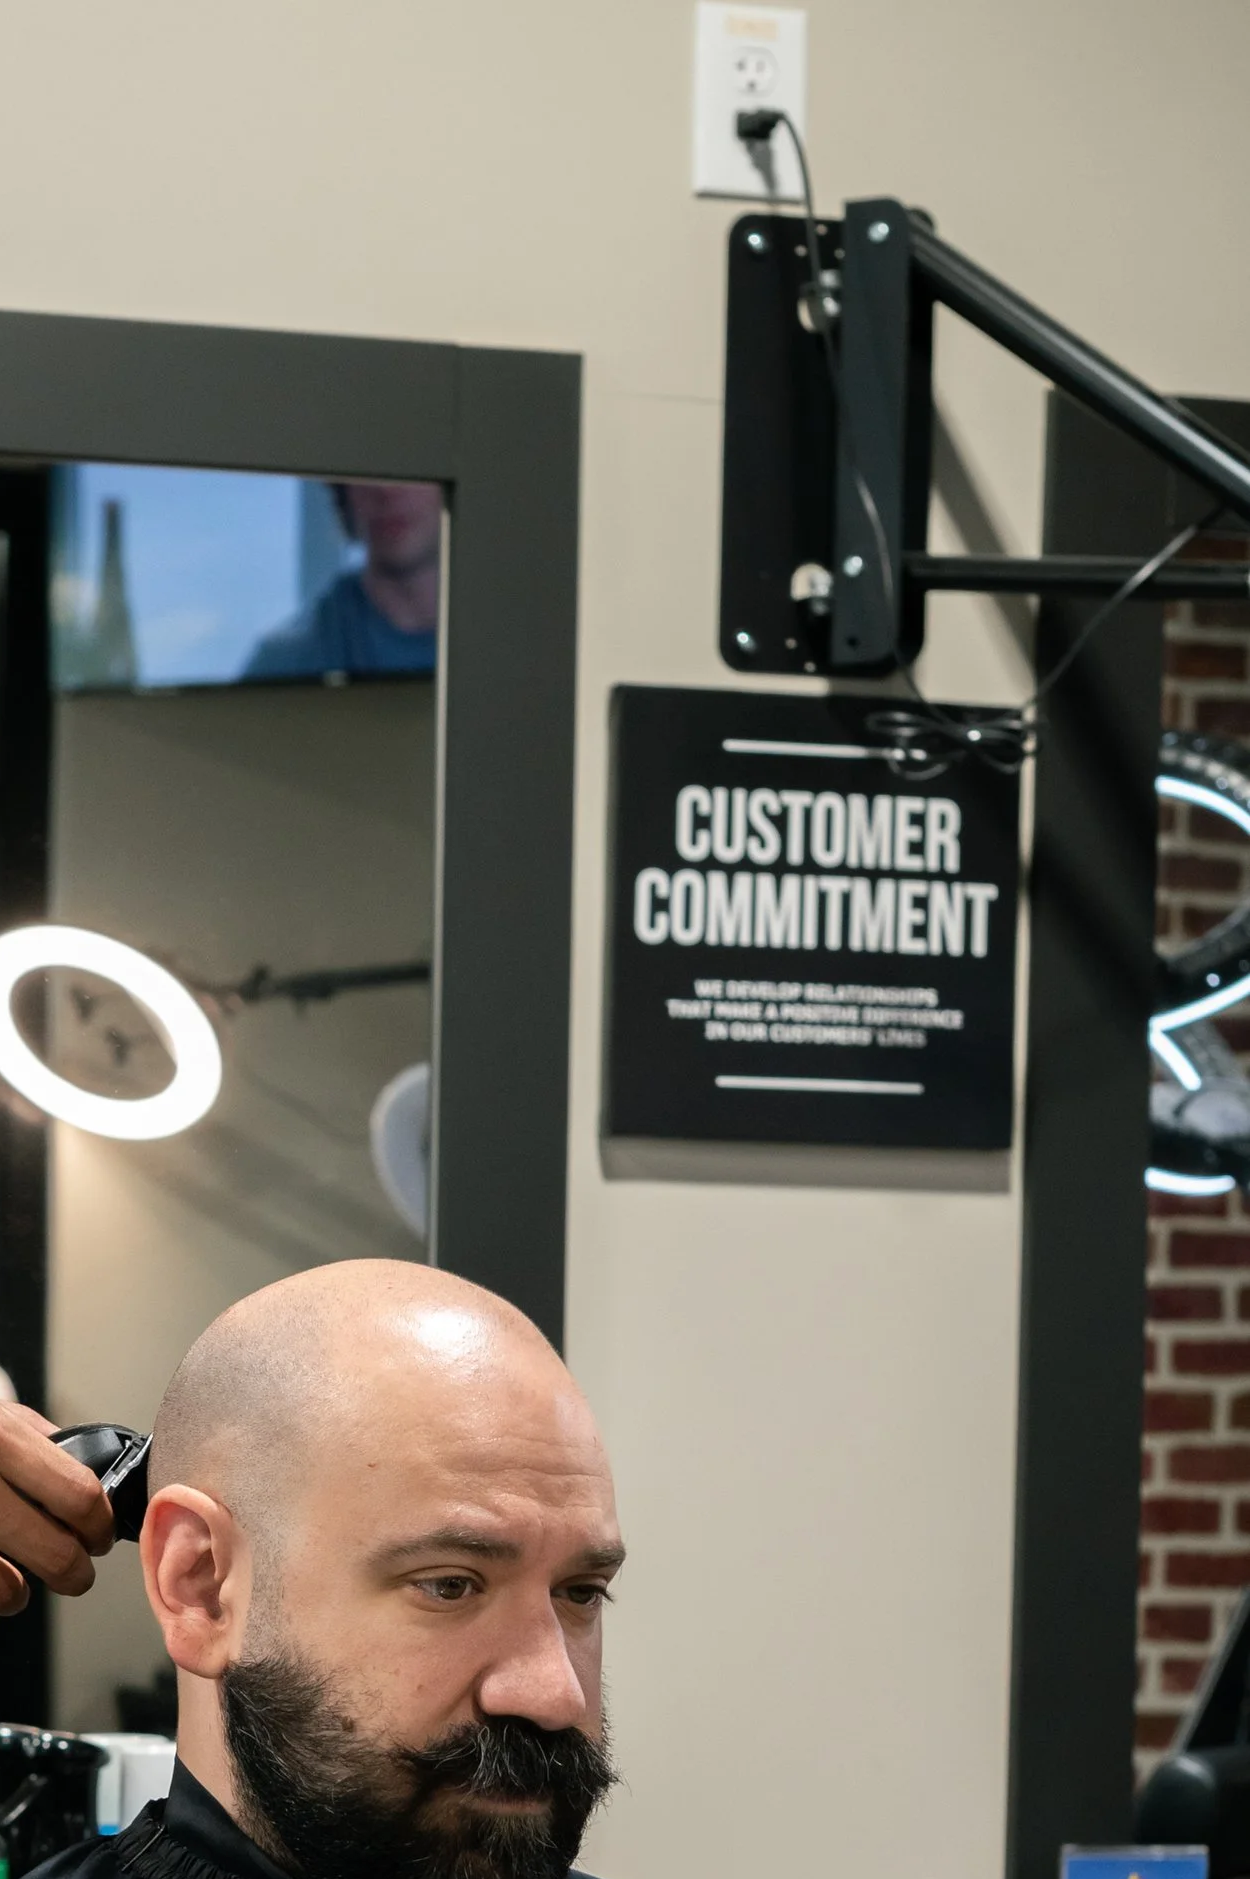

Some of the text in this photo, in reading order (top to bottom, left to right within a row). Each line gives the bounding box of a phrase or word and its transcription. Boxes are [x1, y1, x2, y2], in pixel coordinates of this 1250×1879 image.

[675, 784, 962, 874] CUSTOMER
[633, 866, 999, 958] COMMITMENT
[695, 979, 938, 1008] WE DEVELOP RELATIONSHIPS
[666, 998, 712, 1019] THAT
[713, 1001, 762, 1021] MAKE
[779, 1003, 860, 1025] POSITIVE
[729, 1021, 768, 1042] OUR
